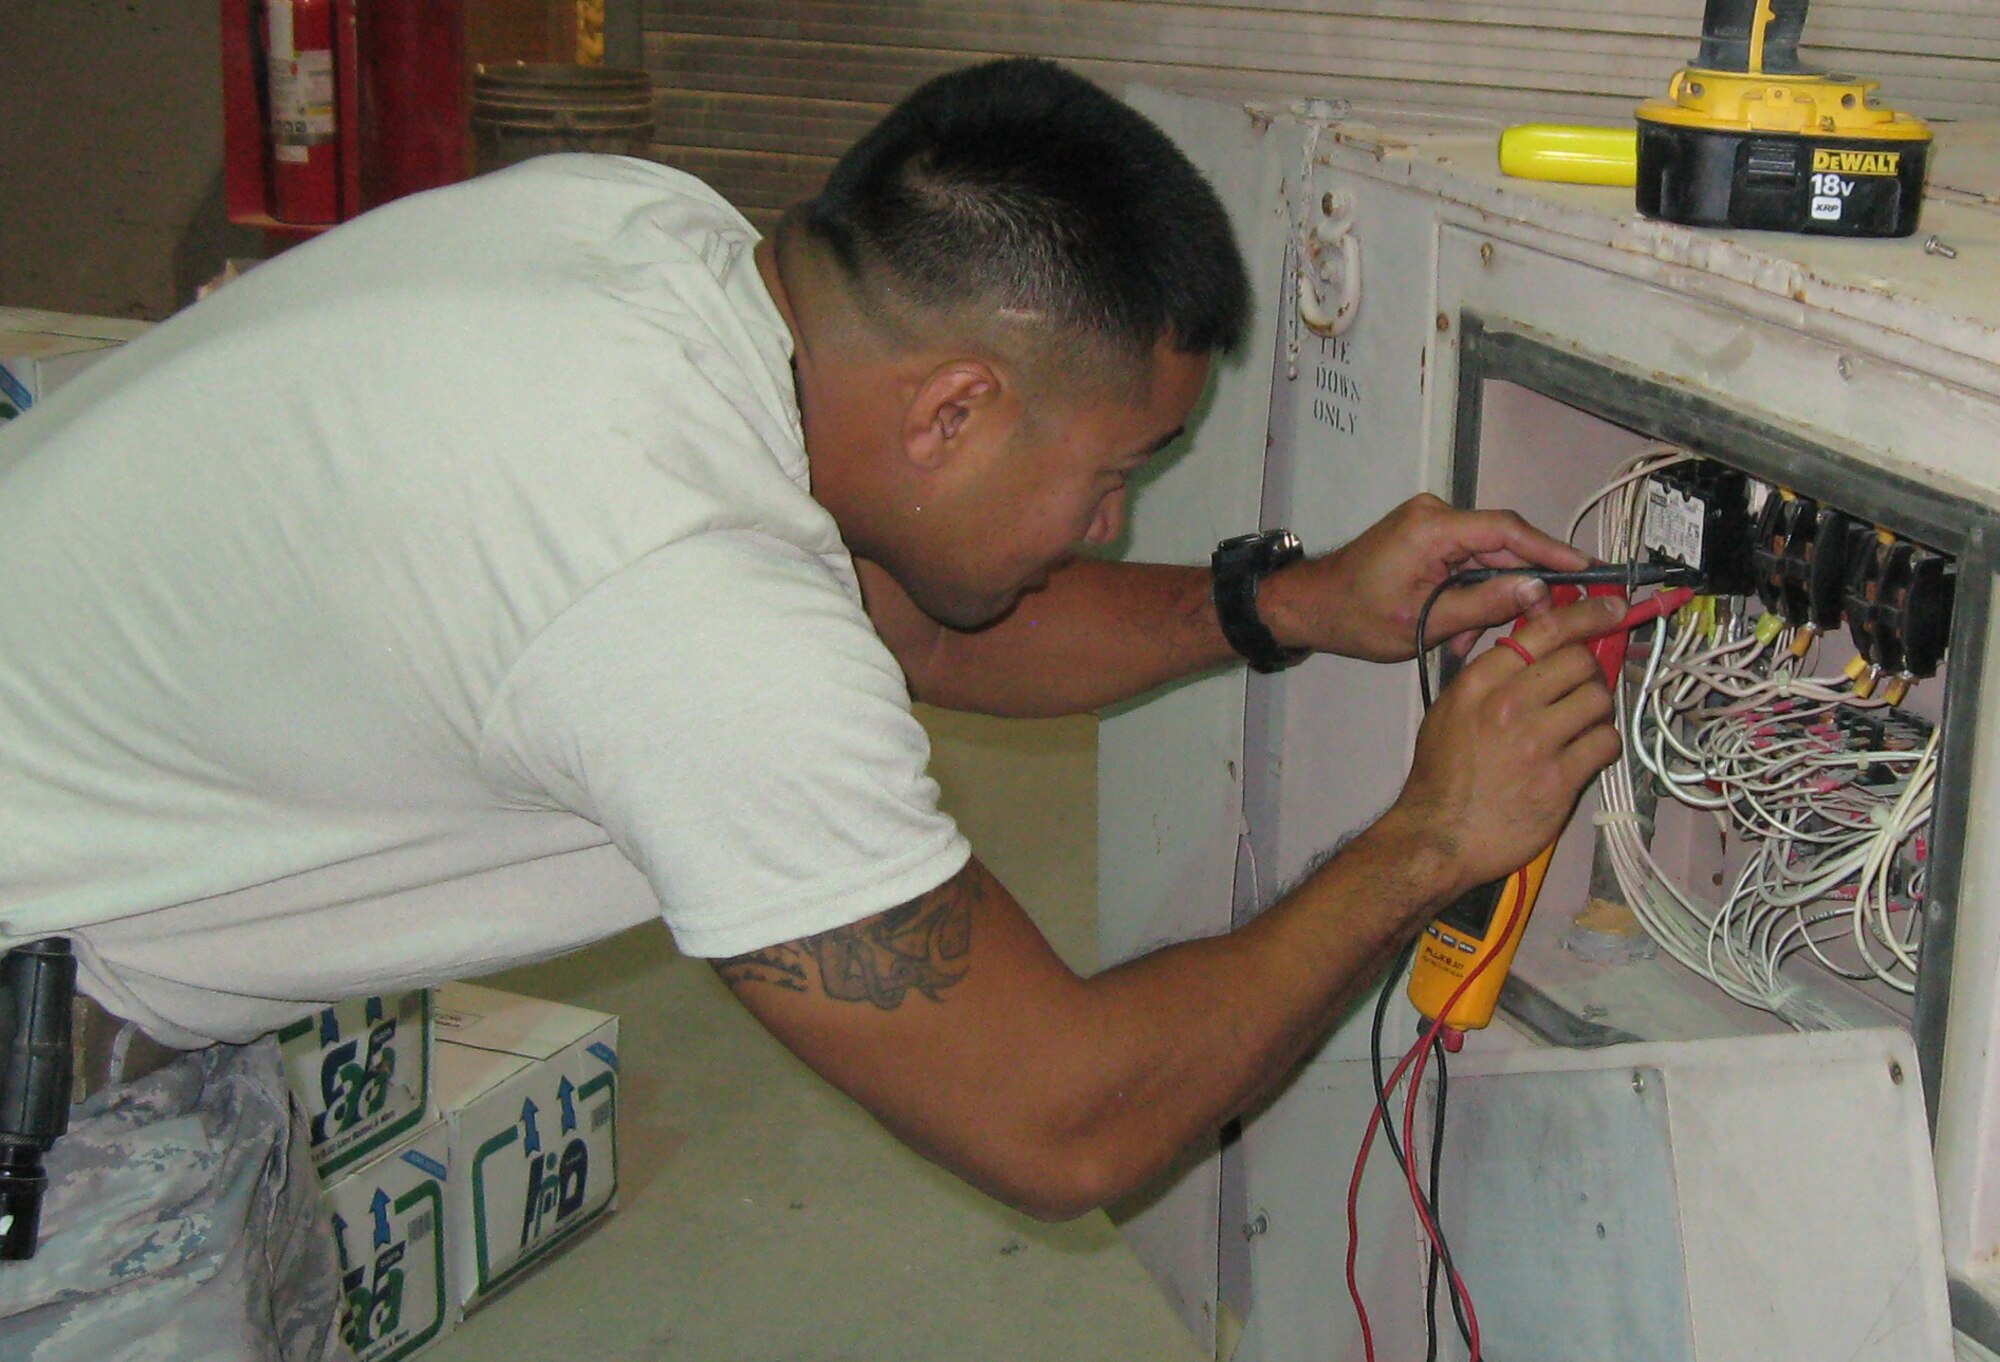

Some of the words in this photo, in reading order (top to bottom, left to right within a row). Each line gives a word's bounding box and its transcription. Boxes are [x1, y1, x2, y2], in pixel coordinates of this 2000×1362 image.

[1814, 151, 1899, 173] DEWALT
[1816, 203, 1839, 212] XRP
[1316, 366, 1360, 401] DOWN
[1313, 399, 1358, 435] ONLY
